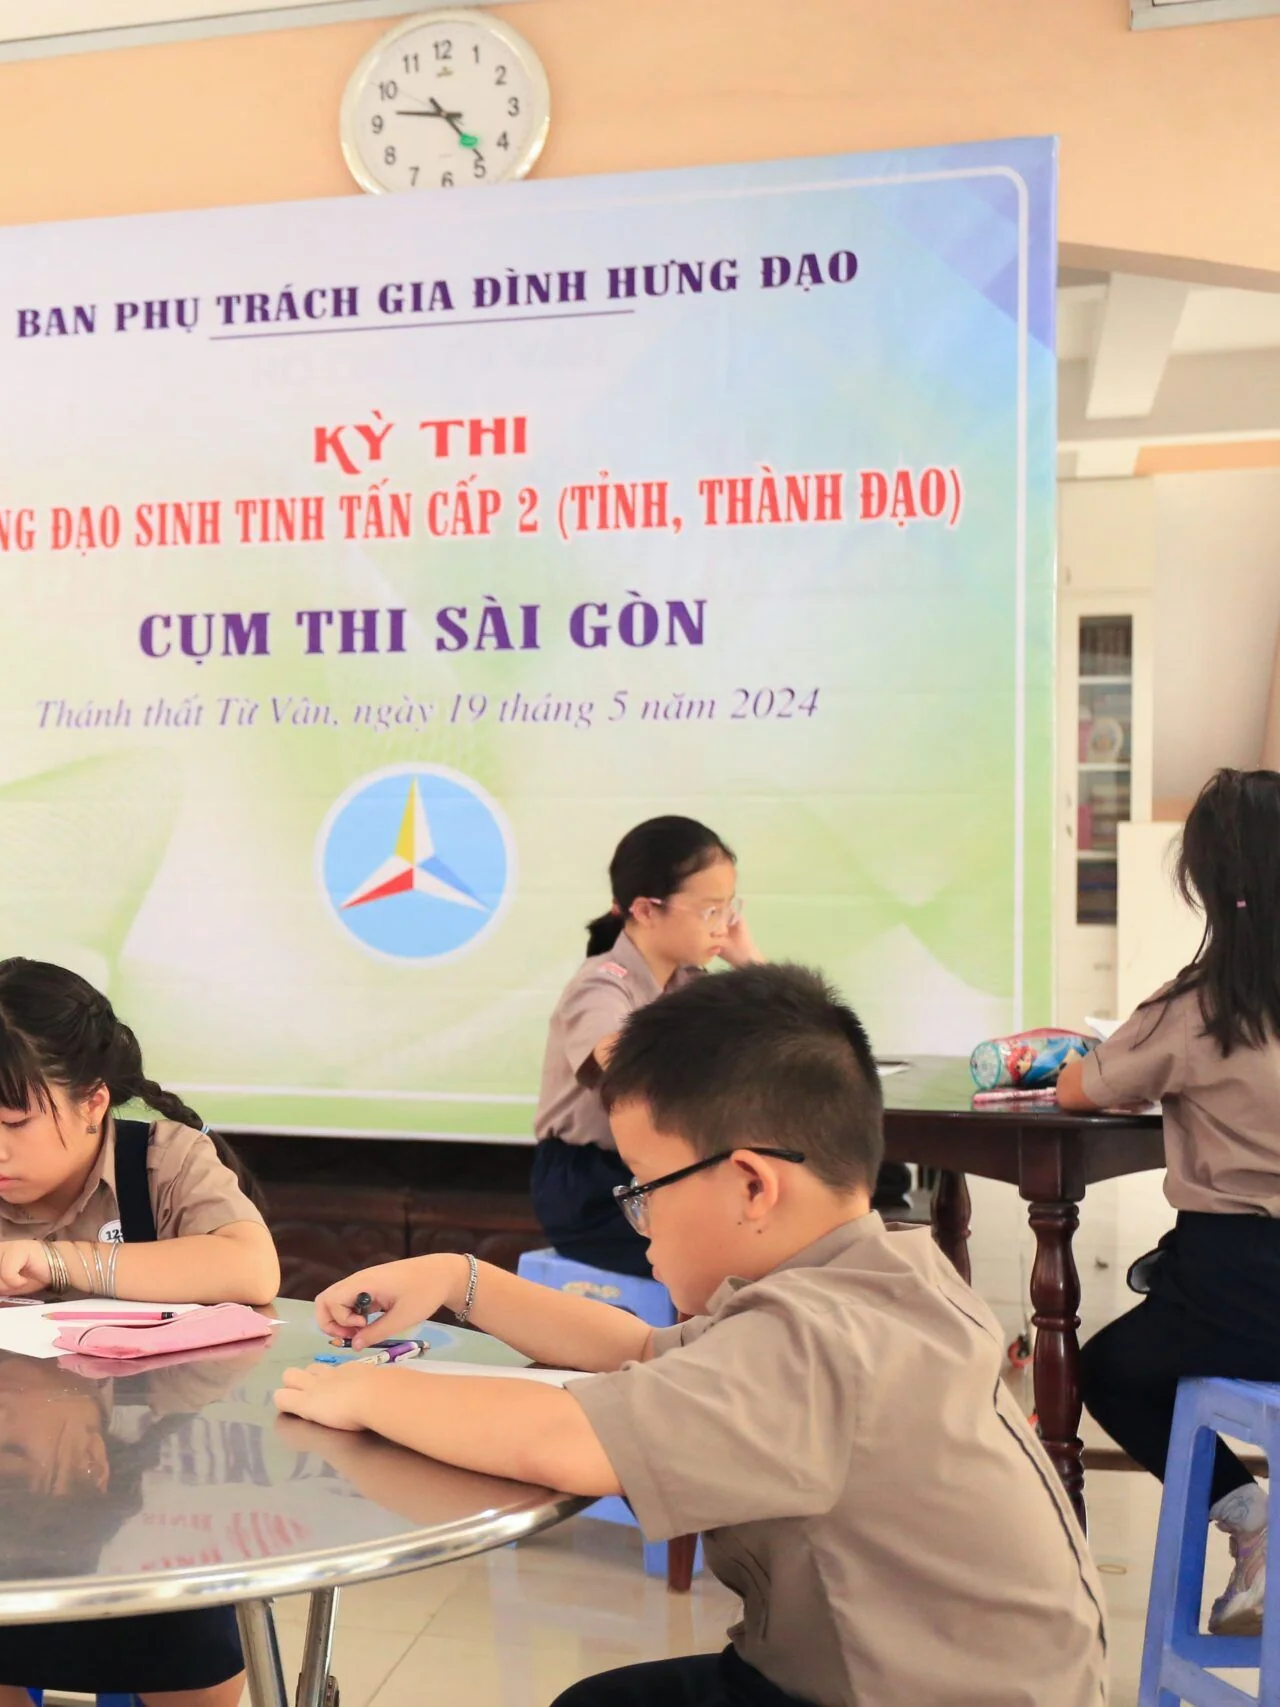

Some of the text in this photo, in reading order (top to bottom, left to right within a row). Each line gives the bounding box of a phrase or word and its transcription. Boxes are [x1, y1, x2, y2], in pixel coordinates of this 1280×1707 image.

[433, 39, 453, 61] 12
[472, 45, 480, 64] 1
[402, 53, 420, 74] 11
[494, 65, 507, 86] 2
[378, 80, 398, 101] 10
[508, 97, 520, 117] 3
[371, 115, 384, 135] 9
[495, 131, 510, 151] 4
[384, 146, 396, 165] 8
[408, 166, 420, 187] 7
[473, 158, 486, 179] 5
[16, 250, 859, 339] BAN PHỤ TRÁCH GIA ĐÌNH HƯNG ĐẠO
[314, 409, 528, 476] KỲ THI
[51, 504, 122, 555] ĐẠO
[135, 500, 222, 548] SINH
[235, 495, 325, 543] TINH
[338, 477, 412, 540] TẤN
[427, 475, 503, 536] CẤP
[517, 487, 539, 534] 2
[558, 471, 683, 539] (TỈNH,
[698, 466, 842, 526] THÀNH
[859, 468, 962, 527] ĐẠO)
[139, 590, 708, 666] CỤM THI SÀI GÒN
[37, 698, 132, 729] Thánh
[143, 693, 205, 727] thất
[217, 697, 260, 726] Từ
[353, 694, 435, 732] ngày
[450, 692, 488, 724] 19
[498, 692, 595, 730] tháng
[607, 689, 629, 722] 5
[640, 692, 717, 721] năm
[730, 686, 822, 720] 2024
[105, 1228, 123, 1241] 12
